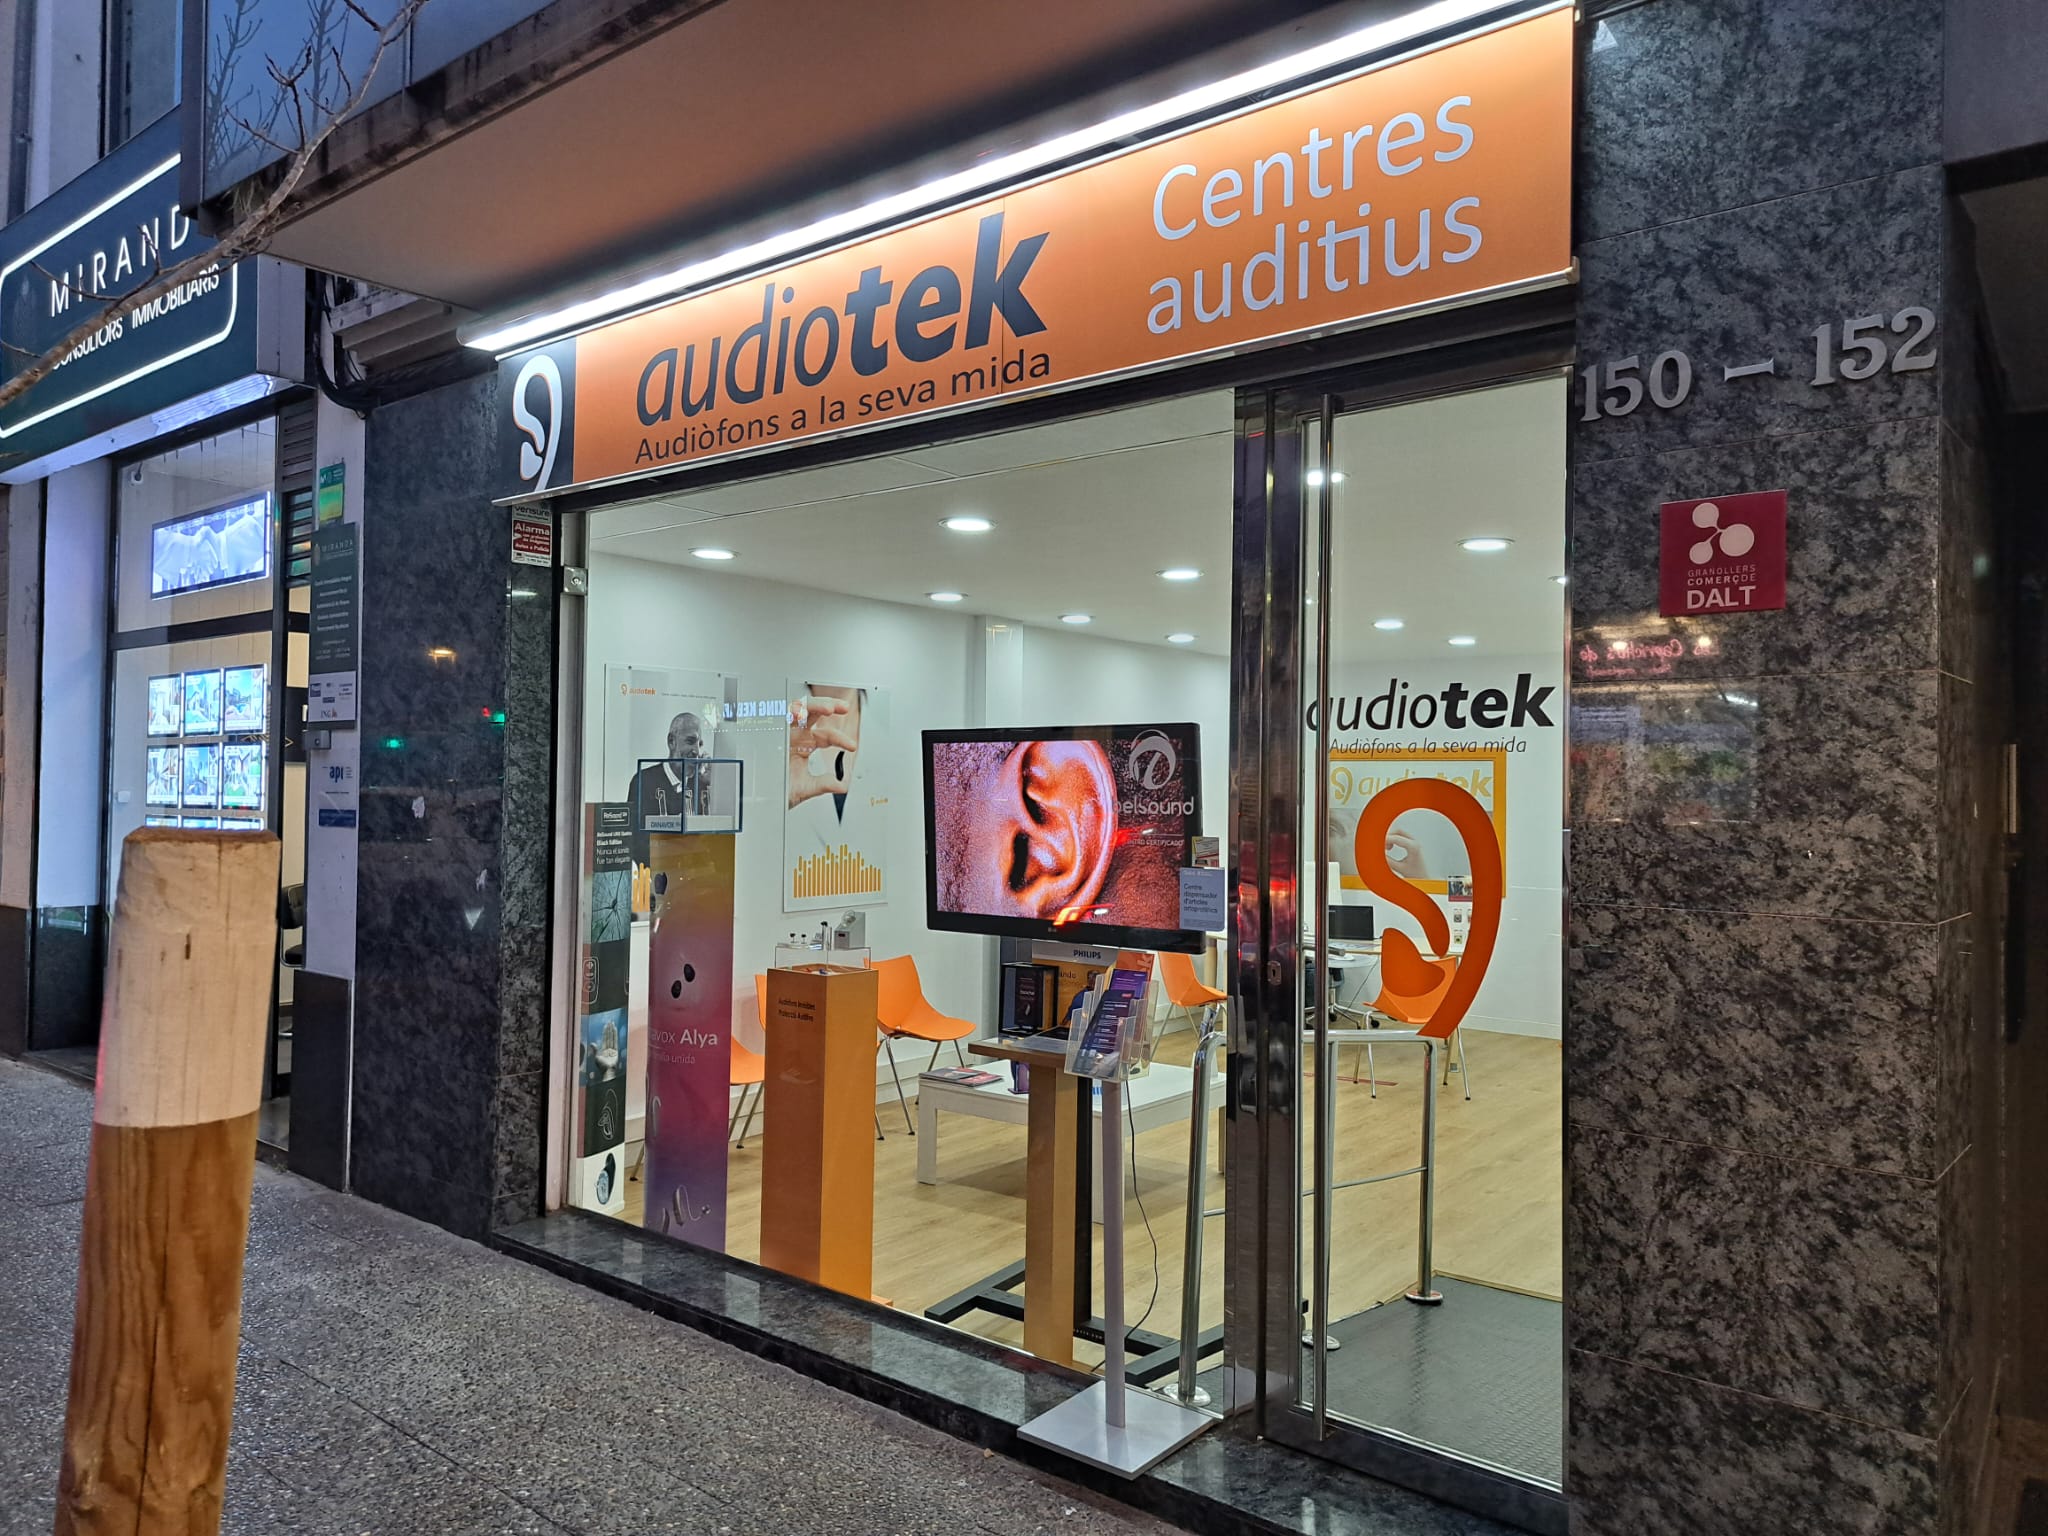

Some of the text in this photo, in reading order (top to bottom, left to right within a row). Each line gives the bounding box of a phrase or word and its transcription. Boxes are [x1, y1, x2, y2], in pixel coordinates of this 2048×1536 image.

[1153, 95, 1475, 241] Centres
[50, 203, 191, 318] MIRAND
[1147, 196, 1483, 334] auditius
[636, 210, 1050, 426] audiotek
[1580, 349, 1693, 423] 150
[1809, 305, 1938, 387] 152
[634, 347, 1051, 464] Audiòfons a la seva mida
[514, 522, 550, 536] Alarma
[1687, 564, 1757, 578] GRANOLLERS
[1686, 585, 1757, 609] DALT
[1306, 673, 1556, 732] audiotek
[1328, 735, 1527, 757] Audiòfons a la seva mida
[329, 766, 344, 784] api
[1072, 948, 1102, 960] PHILIPS
[680, 1028, 719, 1048] Alya
